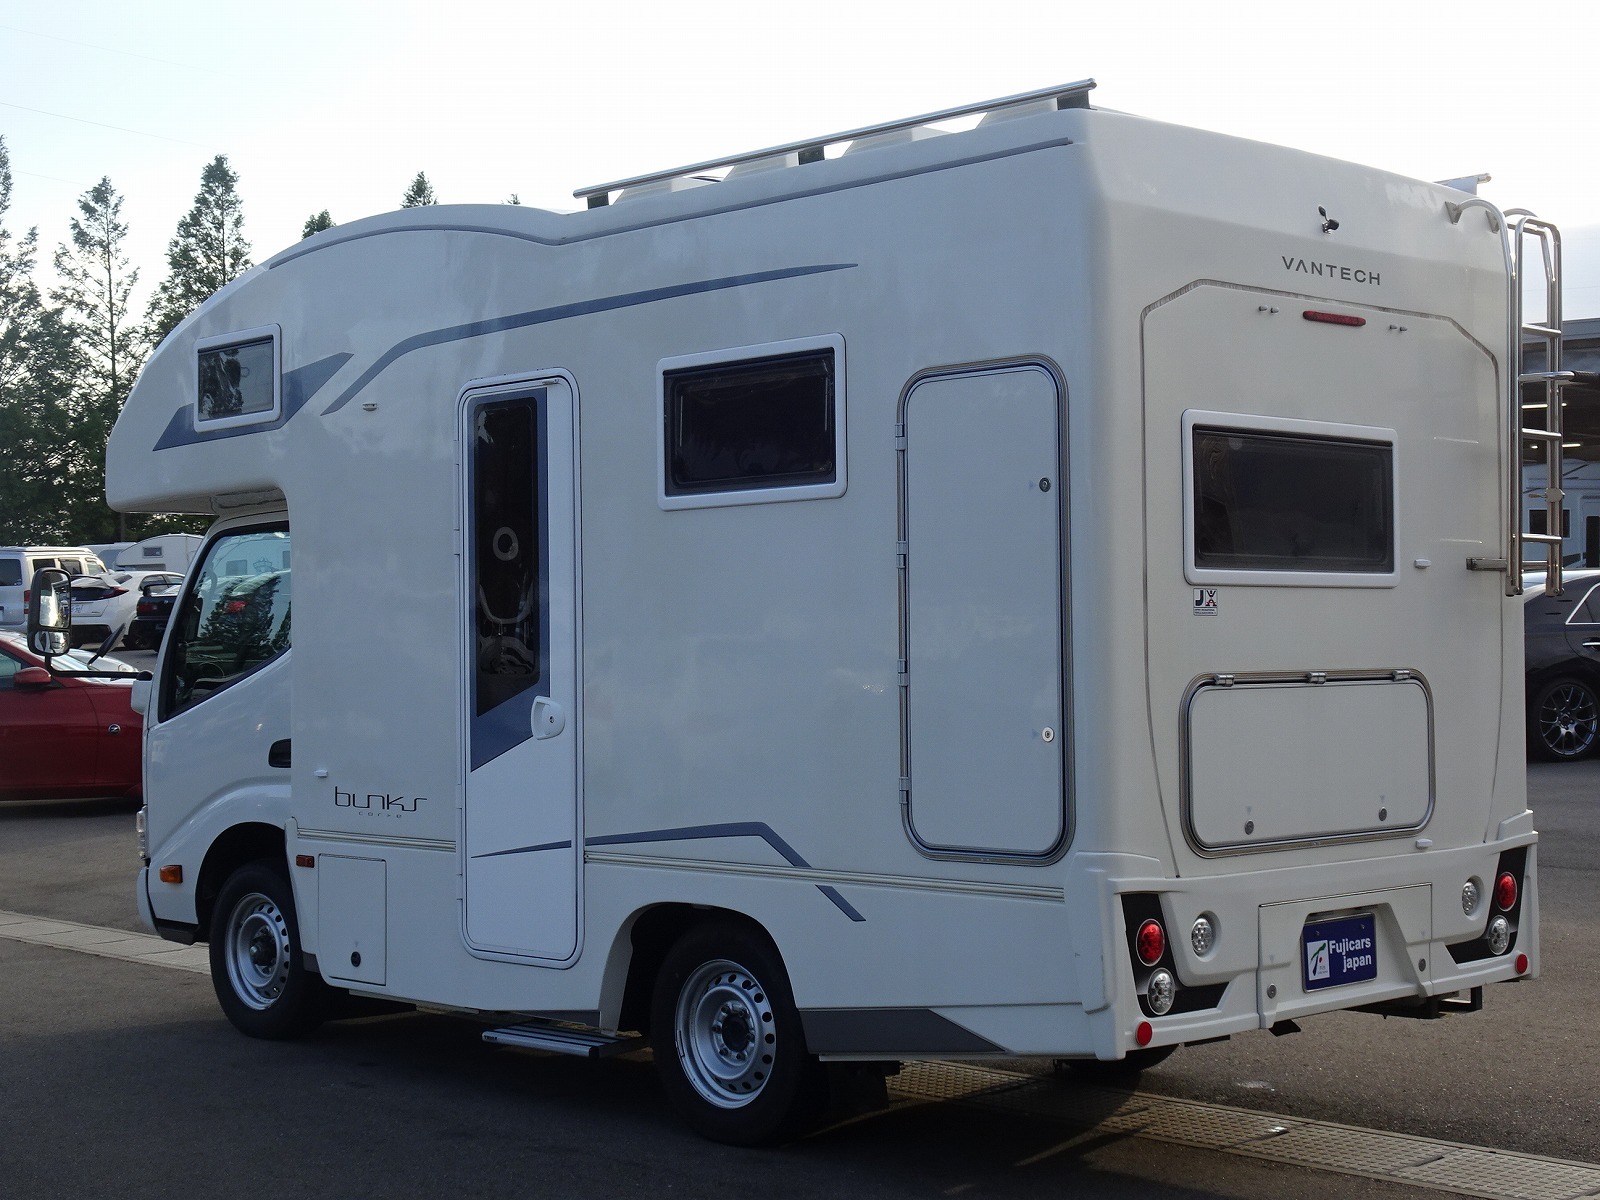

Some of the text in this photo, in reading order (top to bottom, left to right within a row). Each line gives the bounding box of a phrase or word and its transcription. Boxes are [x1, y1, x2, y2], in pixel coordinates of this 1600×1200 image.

[1281, 256, 1381, 285] VANTECH
[335, 786, 428, 812] bunks
[1329, 937, 1372, 956] Fujicars
[1342, 954, 1372, 973] japan
